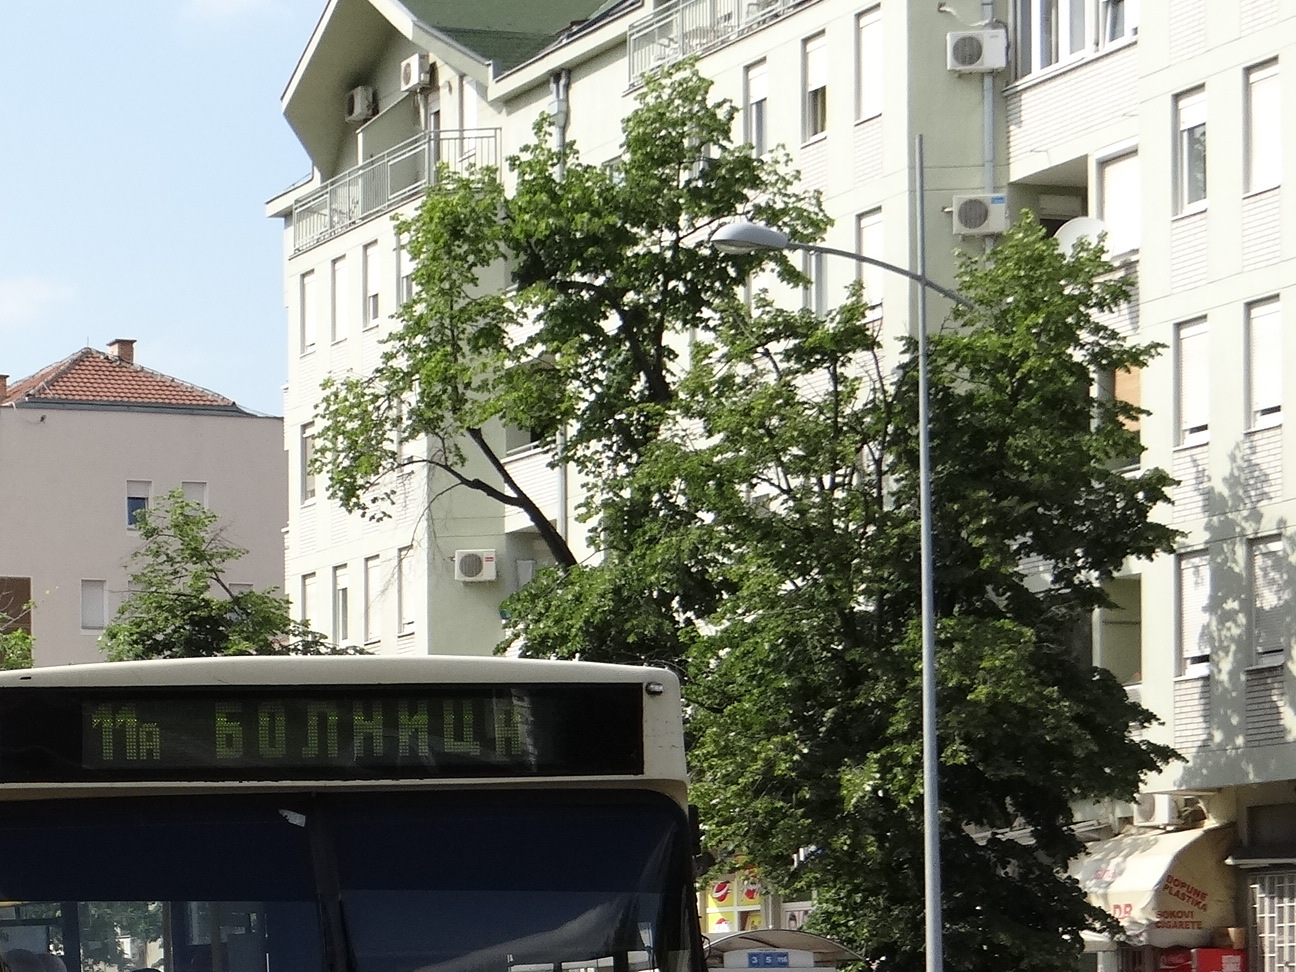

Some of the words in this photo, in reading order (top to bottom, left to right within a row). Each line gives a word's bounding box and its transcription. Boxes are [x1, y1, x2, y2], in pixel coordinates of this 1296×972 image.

[1166, 874, 1209, 900] DOPUNE
[1156, 910, 1194, 919] SOKOVI
[1155, 920, 1203, 930] CIGARETE
[765, 956, 772, 964] 5
